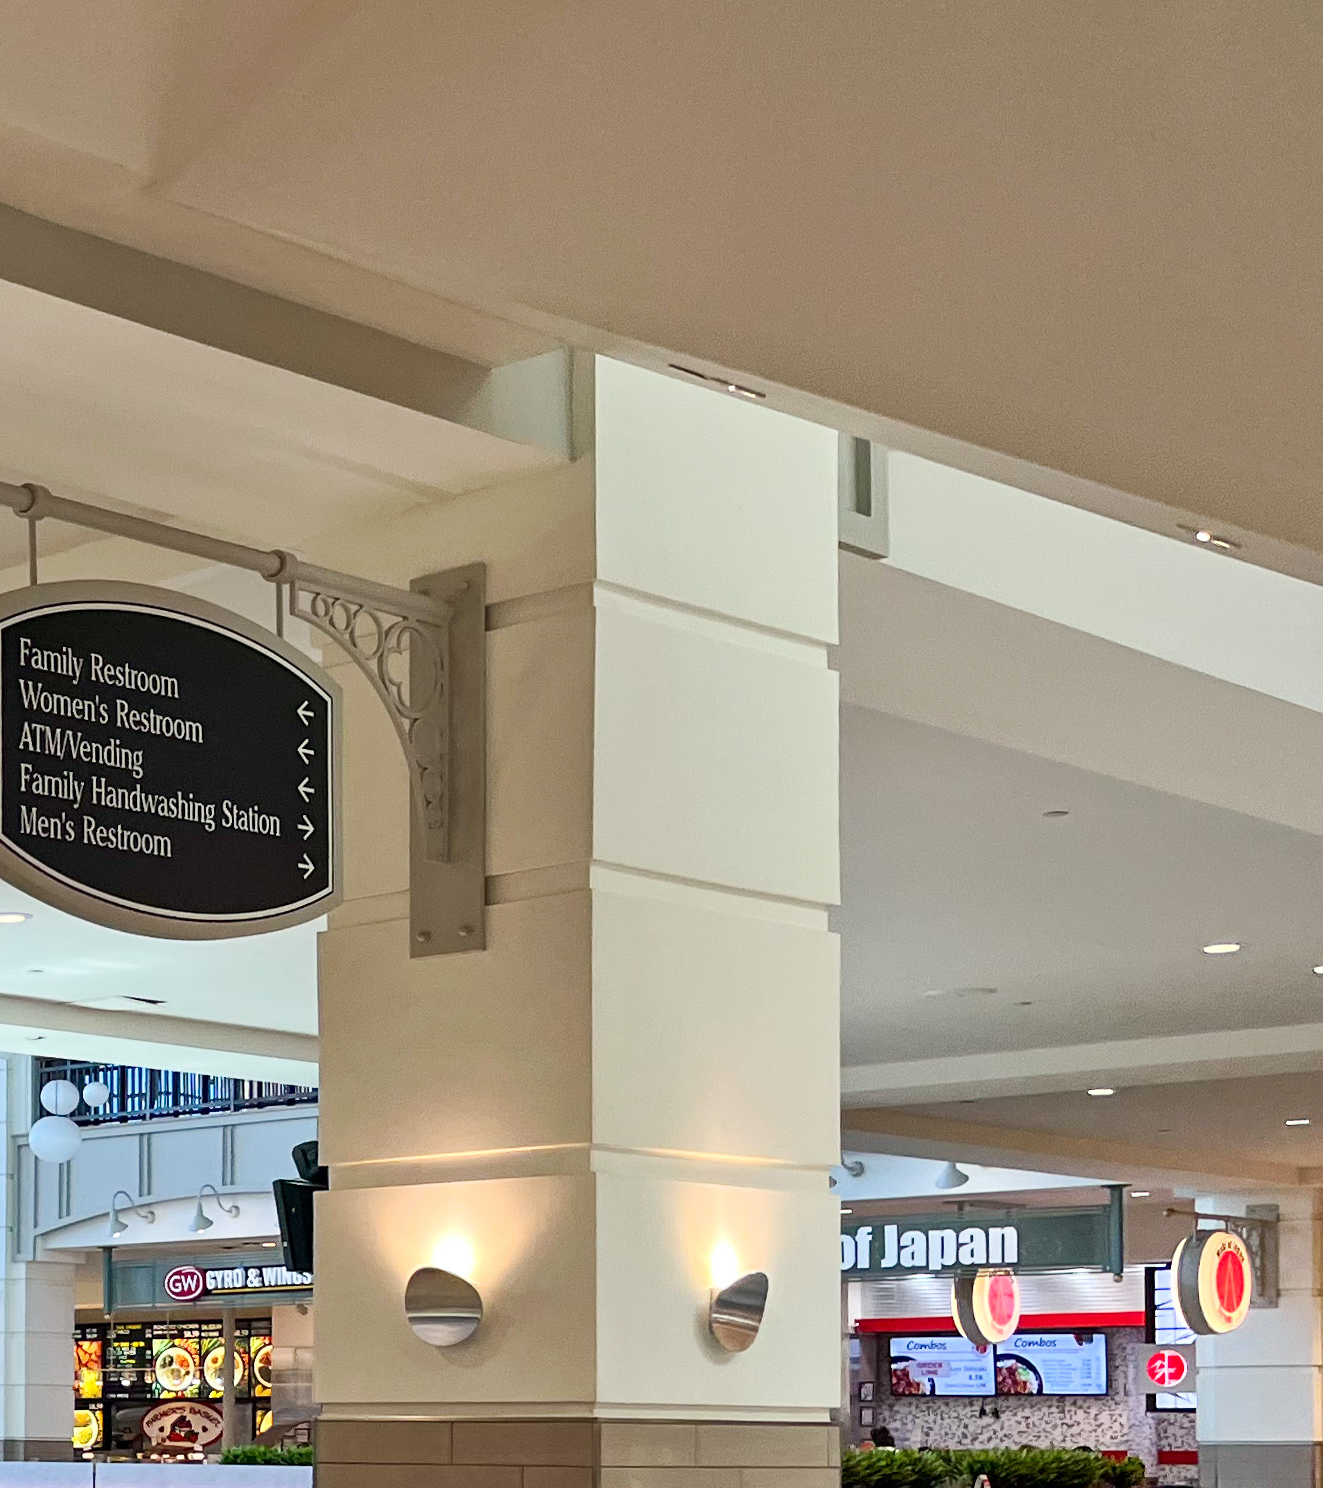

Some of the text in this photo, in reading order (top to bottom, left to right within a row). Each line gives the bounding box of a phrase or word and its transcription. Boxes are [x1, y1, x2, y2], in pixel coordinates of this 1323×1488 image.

[19, 636, 180, 698] Family Restroom
[18, 679, 204, 744] Women's Restroom
[18, 722, 144, 778] ATM/Vending
[20, 763, 281, 837] Family Handwashing Station
[20, 805, 172, 858] Men's Restroom
[880, 1224, 1019, 1270] Japan
[168, 1274, 198, 1294] GW
[205, 1268, 246, 1290] GYRO
[246, 1268, 263, 1288] &
[907, 1340, 948, 1351] Combos
[1014, 1337, 1057, 1348] Combos
